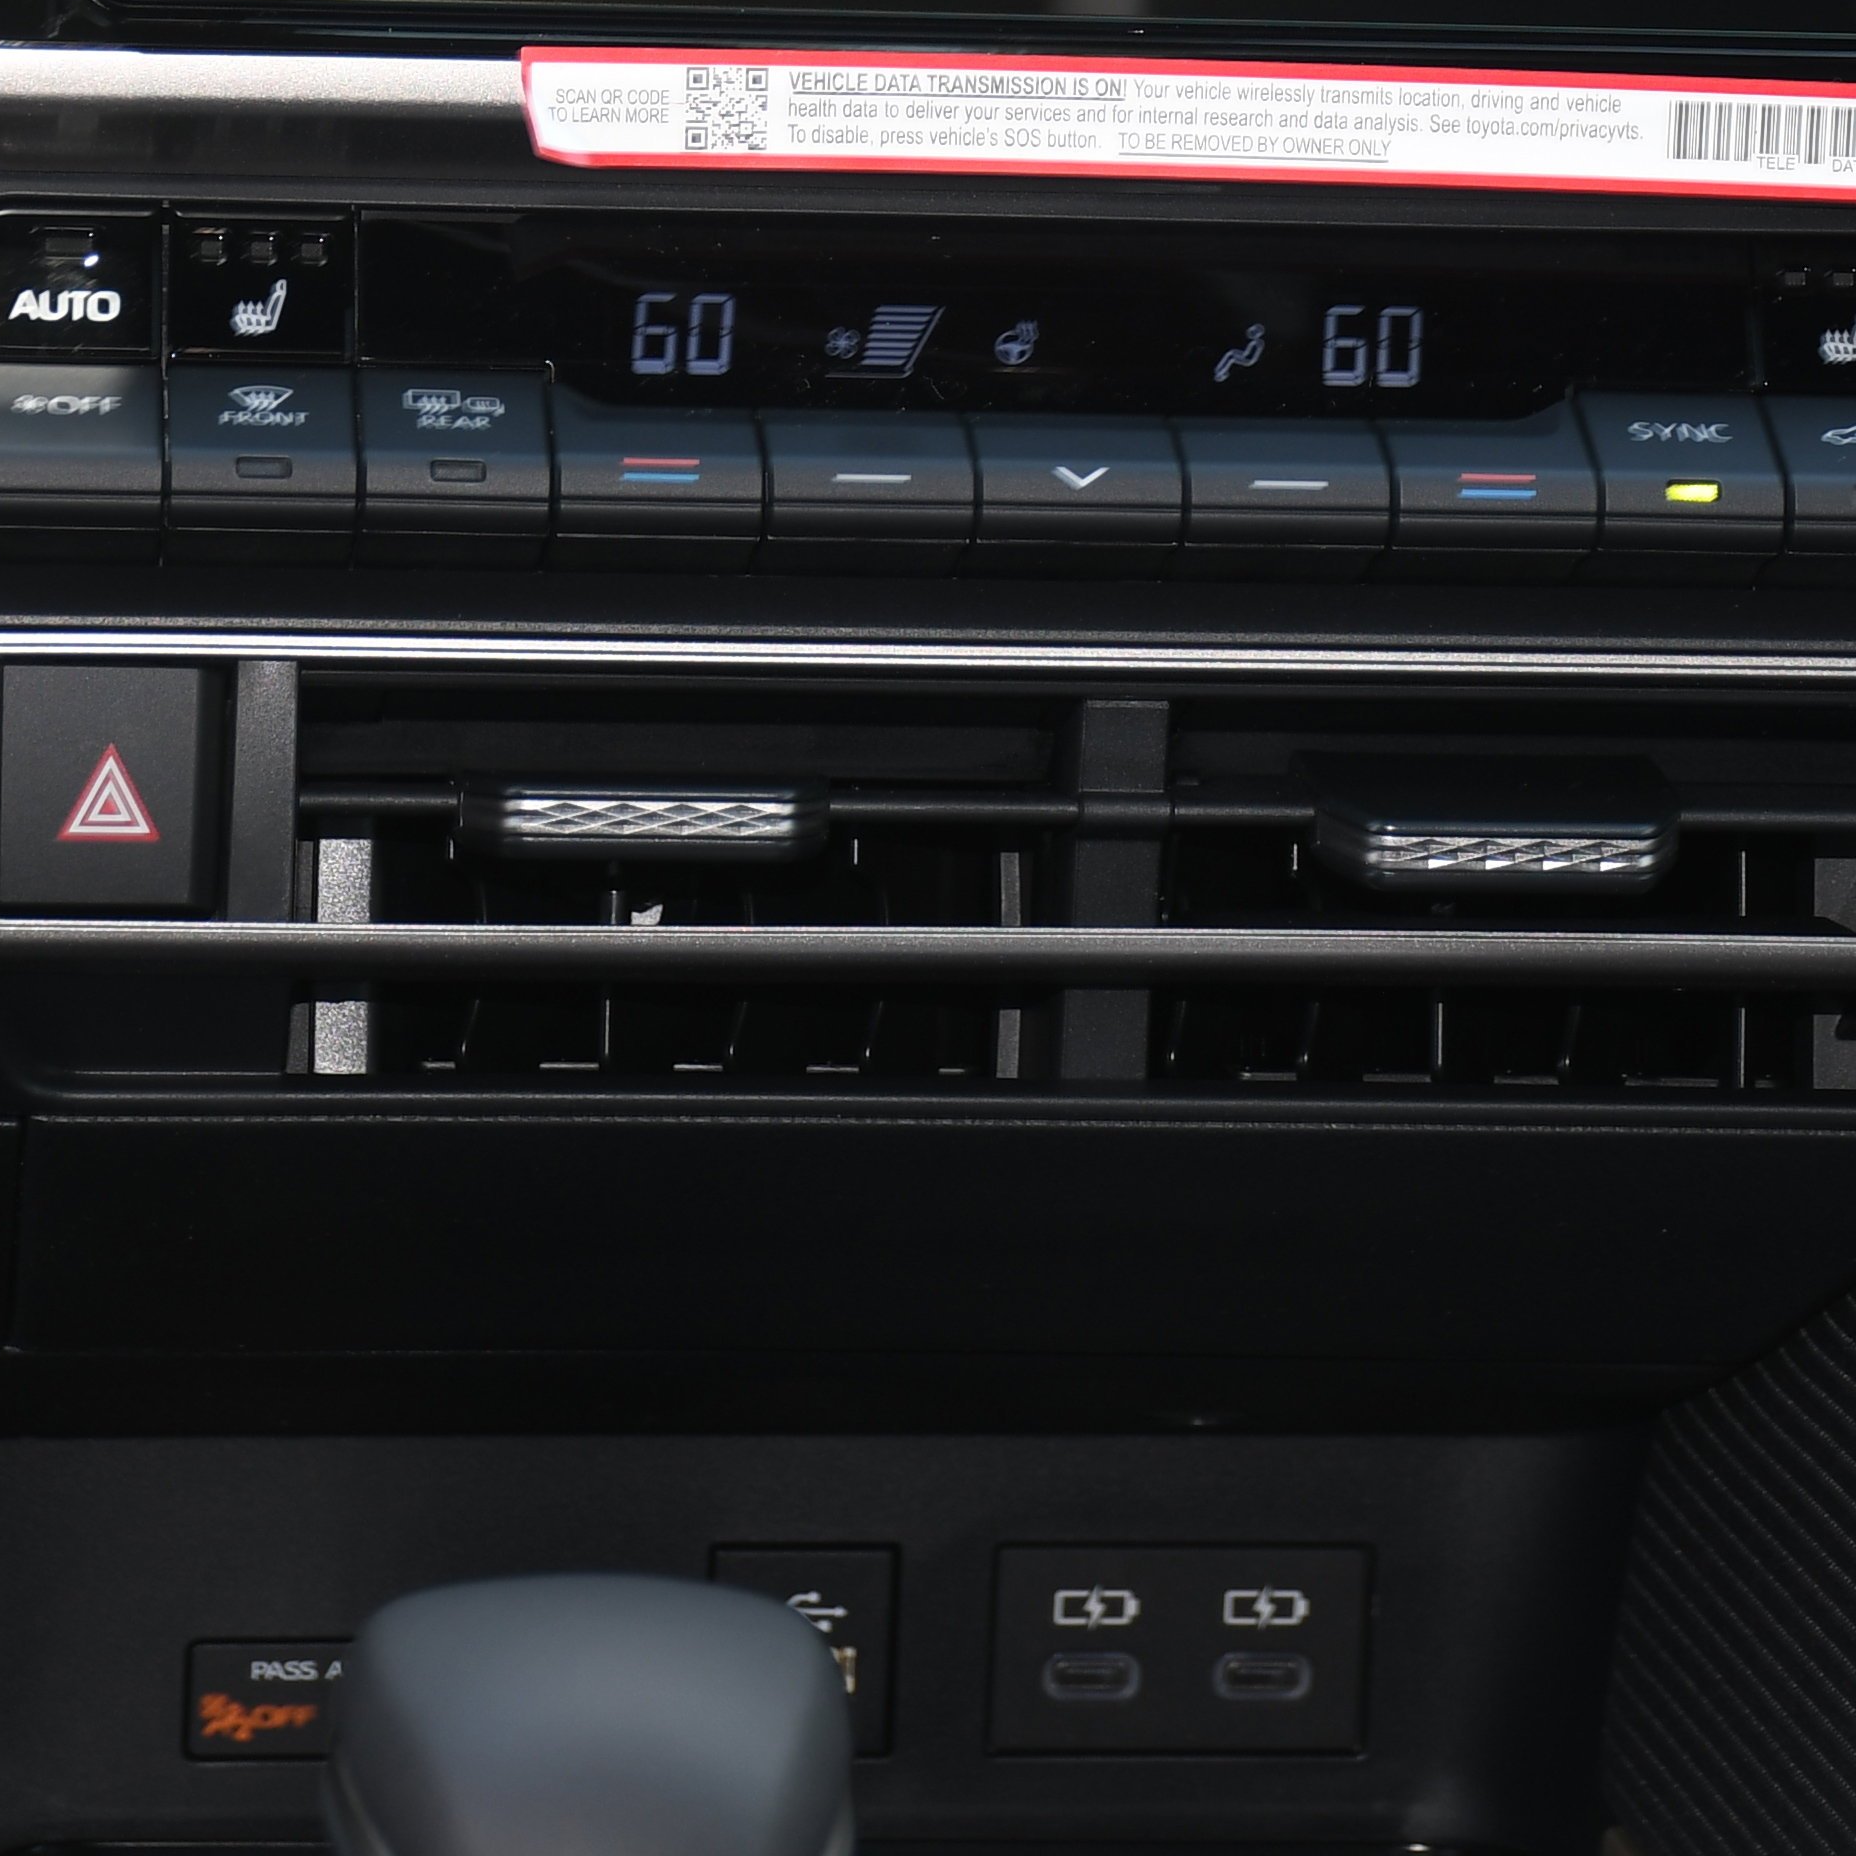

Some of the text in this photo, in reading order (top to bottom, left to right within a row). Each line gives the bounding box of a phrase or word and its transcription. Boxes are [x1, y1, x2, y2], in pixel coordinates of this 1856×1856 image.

[555, 88, 670, 106] SCAN QR CODE
[789, 71, 1621, 114] VEHICLE DATA TRANSMISSION IS ON! Your vehicle wirelessly transmits location, driving and vehicle
[548, 106, 670, 124] TO LEARN MORE
[788, 97, 1644, 142] health data to deliver your services and for internal research and data analysis. See toyota.com/privacyvts.
[787, 123, 1391, 157] To disable, press vehicle's SOS button. TO BE REMOVED BY OWNER ONLY
[1756, 156, 1796, 171] TELE
[8, 288, 122, 323] AUTO
[631, 291, 736, 377] 60
[1323, 304, 1424, 388] 60
[45, 393, 124, 417] OFF
[217, 409, 310, 428] FRONT
[416, 414, 492, 430] REAR
[1627, 421, 1734, 443] SYNC
[250, 1659, 319, 1681] PASS
